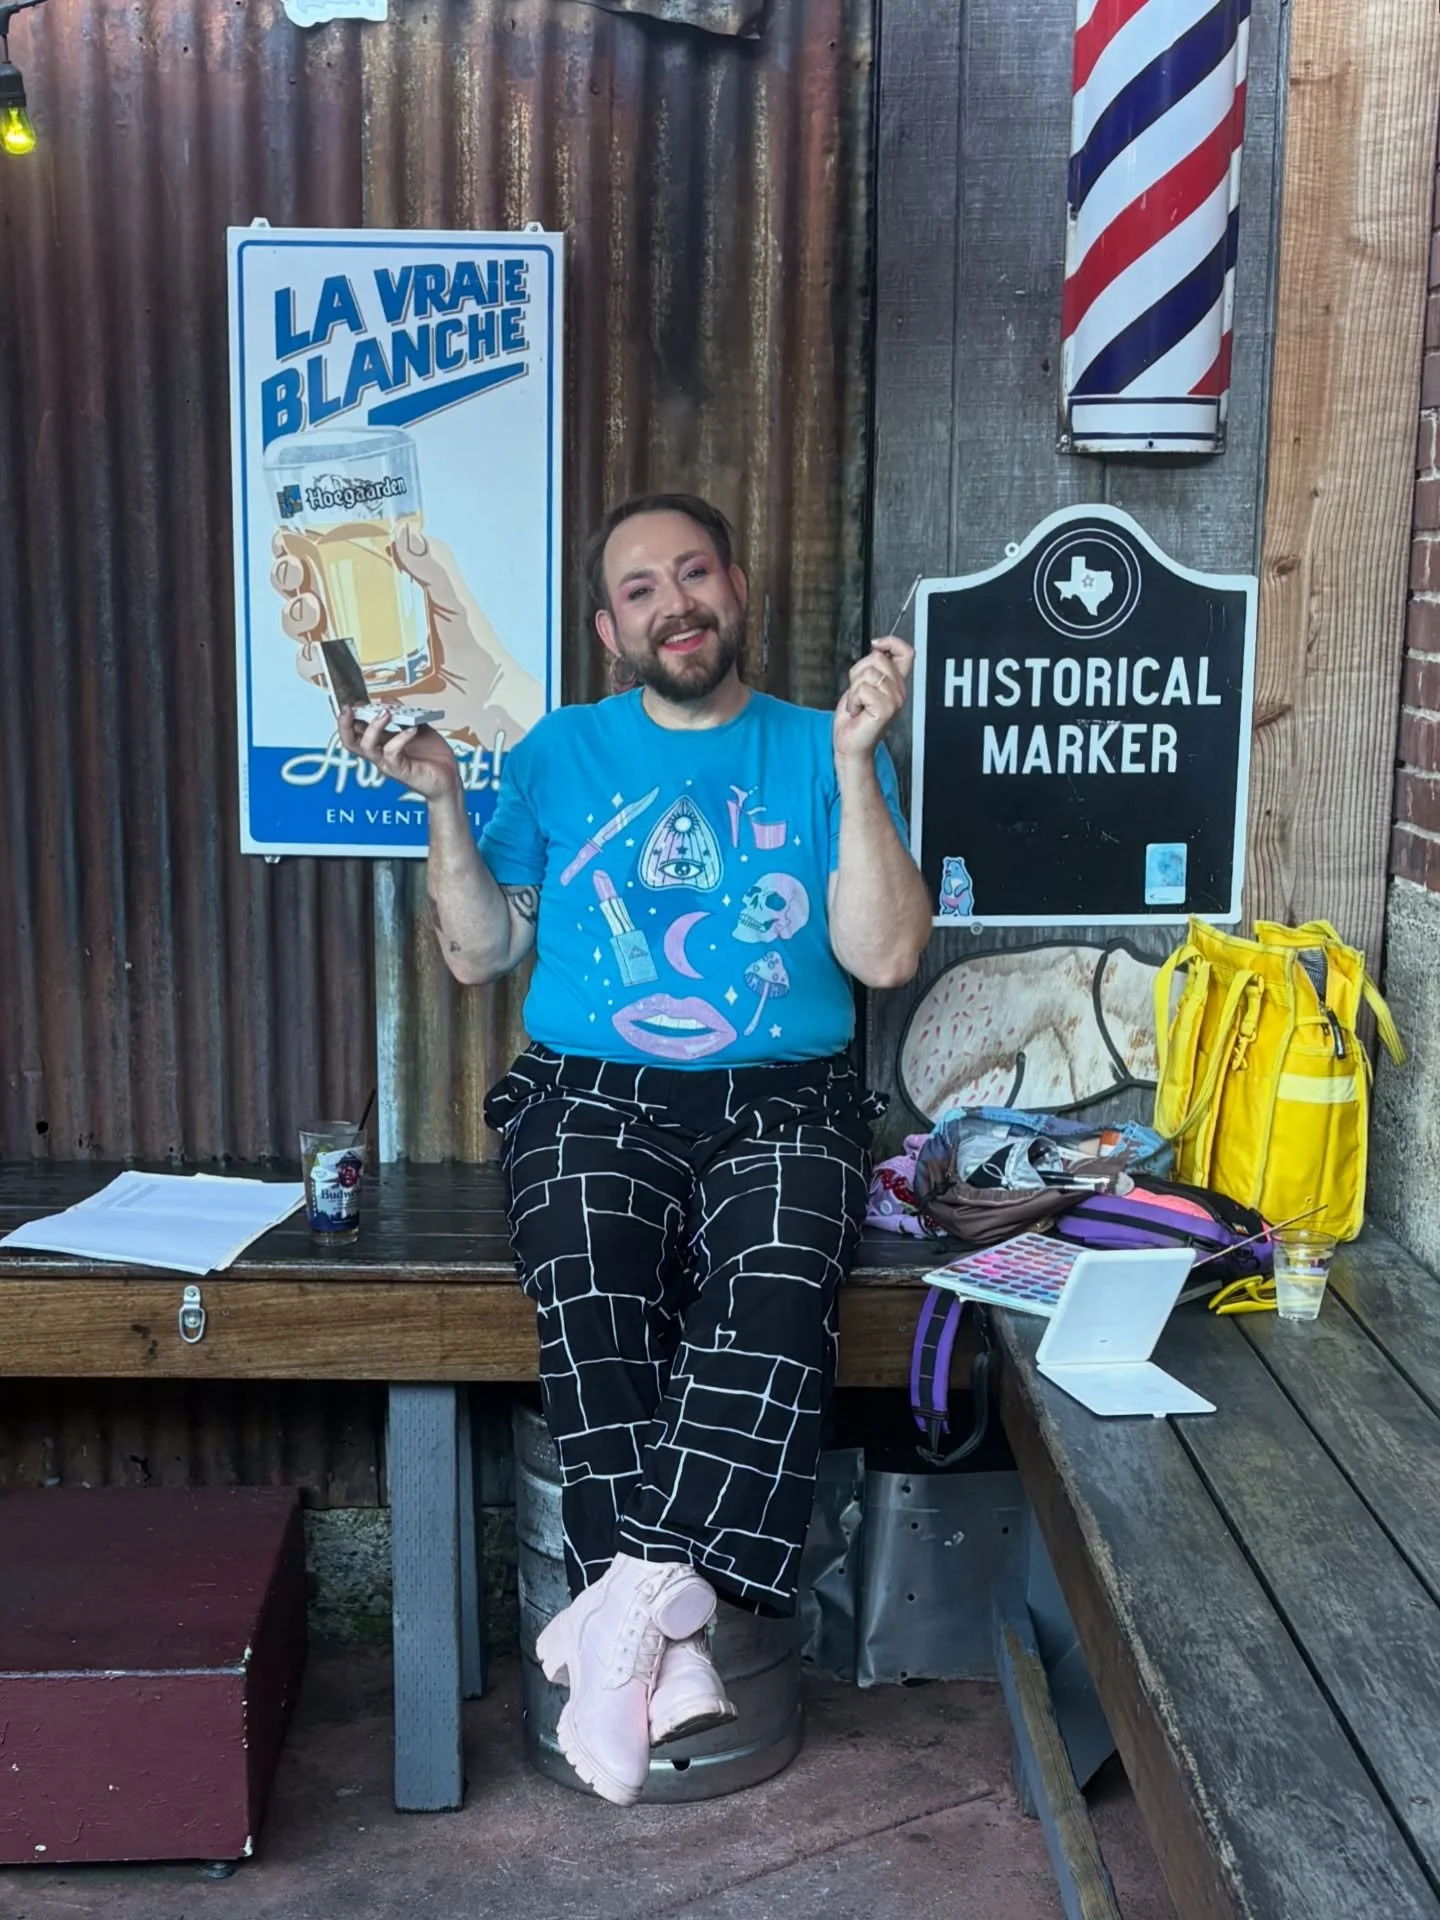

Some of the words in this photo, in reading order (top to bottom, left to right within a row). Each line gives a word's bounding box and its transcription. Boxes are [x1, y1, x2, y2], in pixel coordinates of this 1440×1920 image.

[274, 274, 367, 363] LA
[373, 258, 530, 326] VRAIE
[261, 307, 530, 456] BLANCHE
[305, 476, 407, 511] Hoegaarden
[943, 656, 1222, 707] HISTORICAL
[982, 723, 1179, 774] MARKER
[326, 808, 355, 823] EN
[366, 809, 426, 825] VENT
